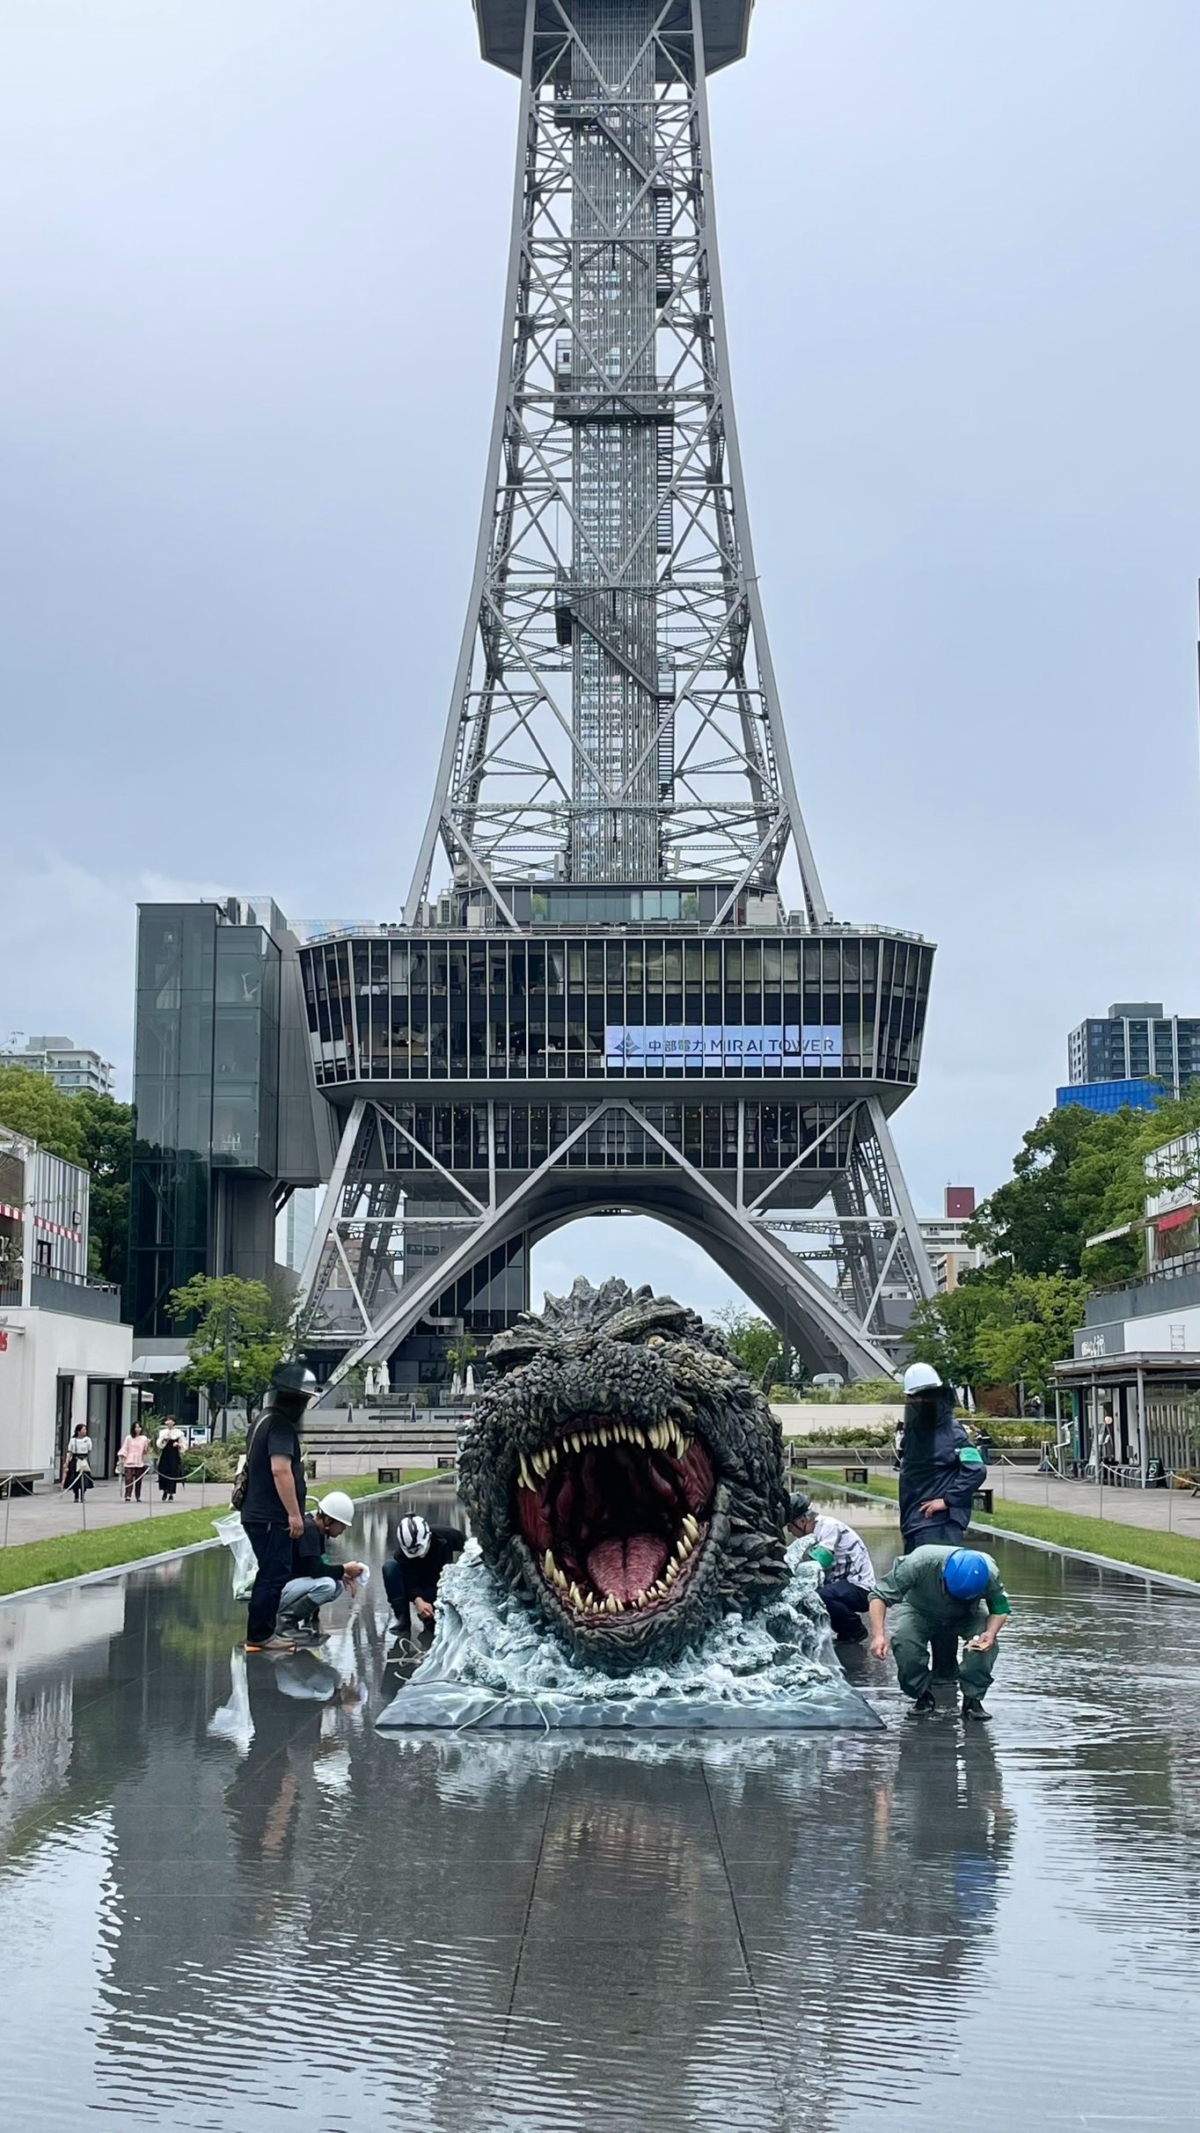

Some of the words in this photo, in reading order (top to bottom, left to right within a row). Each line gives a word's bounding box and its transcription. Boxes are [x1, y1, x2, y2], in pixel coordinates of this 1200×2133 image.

[648, 1039, 706, 1052] 中部電力
[710, 1039, 763, 1052] MIRAI
[768, 1039, 835, 1052] TOWER
